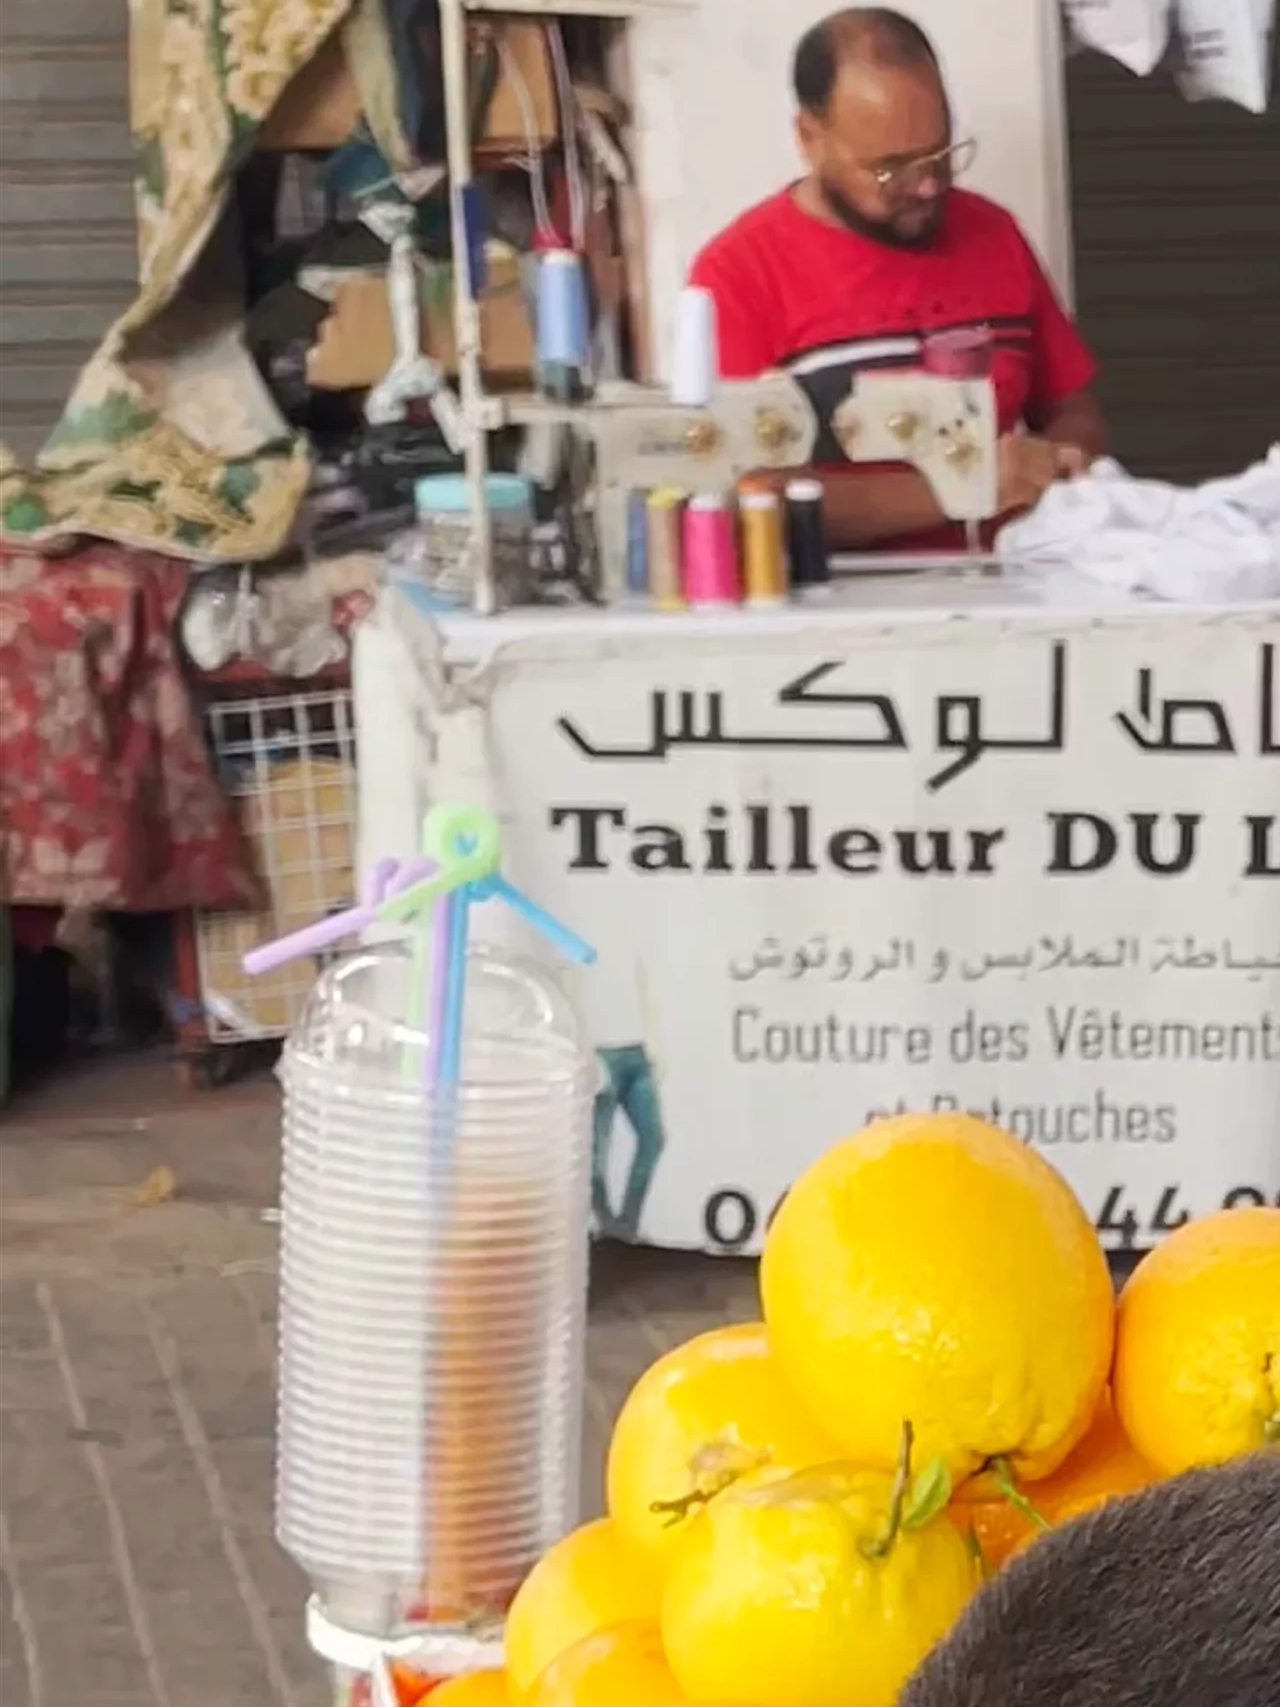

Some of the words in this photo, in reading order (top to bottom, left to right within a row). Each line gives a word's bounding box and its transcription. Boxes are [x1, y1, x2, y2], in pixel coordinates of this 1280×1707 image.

[555, 639, 1067, 793] لوكس
[550, 804, 1006, 875] Tailleur
[1045, 810, 1203, 875] DU
[728, 936, 915, 982] الروتوش
[959, 934, 1140, 983] الملابس
[731, 1004, 933, 1064] Couture
[948, 1008, 1030, 1063] des
